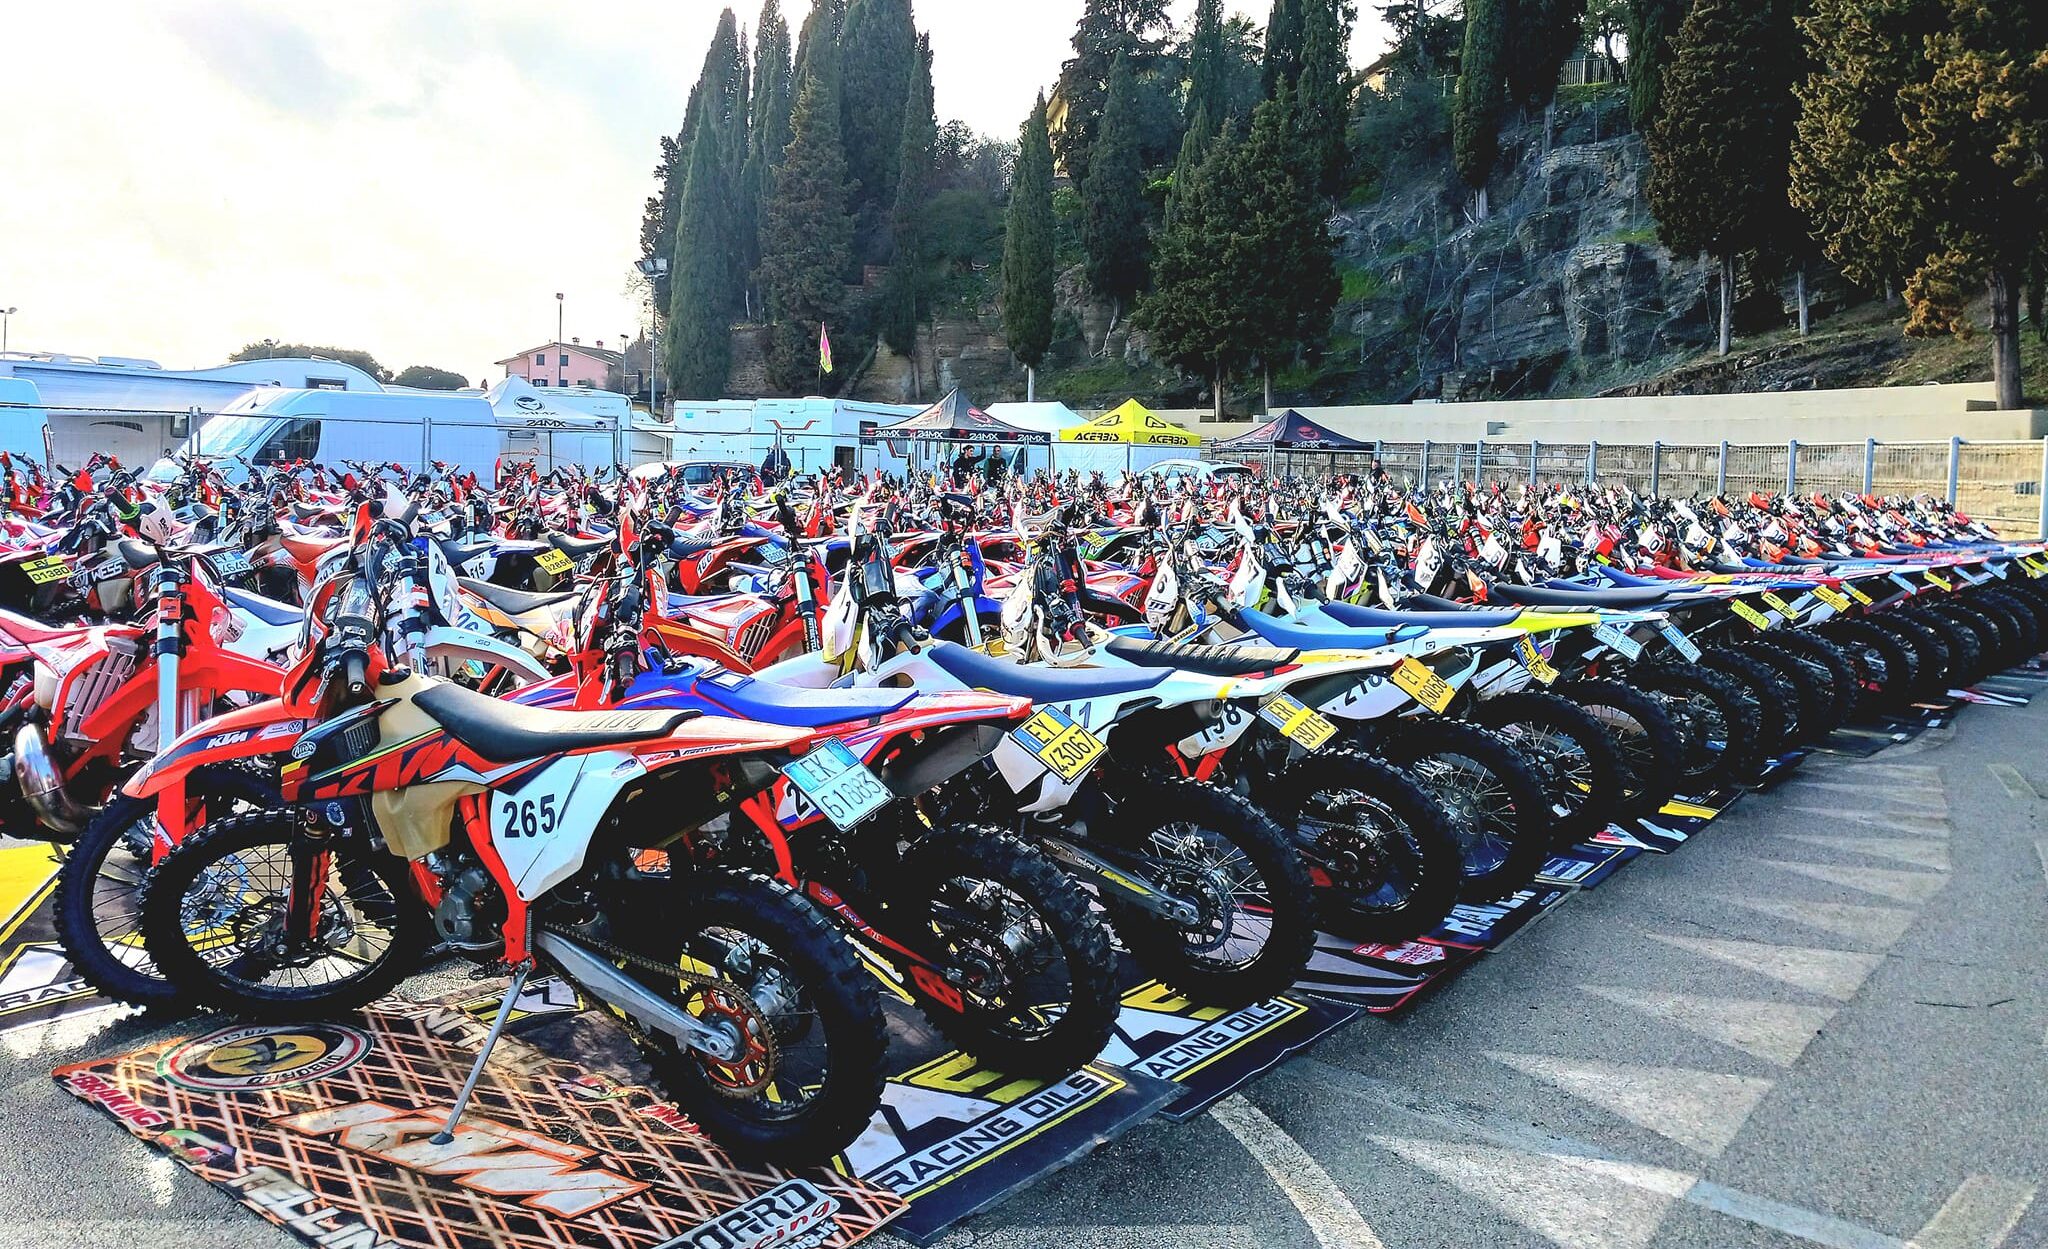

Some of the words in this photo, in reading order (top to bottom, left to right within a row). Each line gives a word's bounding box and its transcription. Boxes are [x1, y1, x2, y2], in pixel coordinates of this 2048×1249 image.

[526, 419, 567, 428] 24MX
[875, 430, 900, 438] 24MX
[917, 430, 944, 438] 24MX
[968, 432, 999, 441] 24MX
[1017, 434, 1046, 443] 24MX
[1074, 432, 1120, 442] ACERBIS
[1148, 434, 1189, 445] ACERBIS
[1291, 441, 1320, 449] 24MX
[542, 552, 558, 562] DX
[1267, 702, 1297, 722] ER
[1025, 718, 1056, 744] EY
[206, 731, 248, 749] KTM
[1049, 728, 1096, 773] 43067
[800, 754, 838, 783] EK
[502, 794, 556, 838] 265
[1146, 1032, 1232, 1077] ACING
[1221, 1001, 1284, 1033] OILS
[71, 1073, 165, 1128] BRAKING
[873, 1117, 1024, 1194] RACING
[1018, 1074, 1101, 1120] OILS
